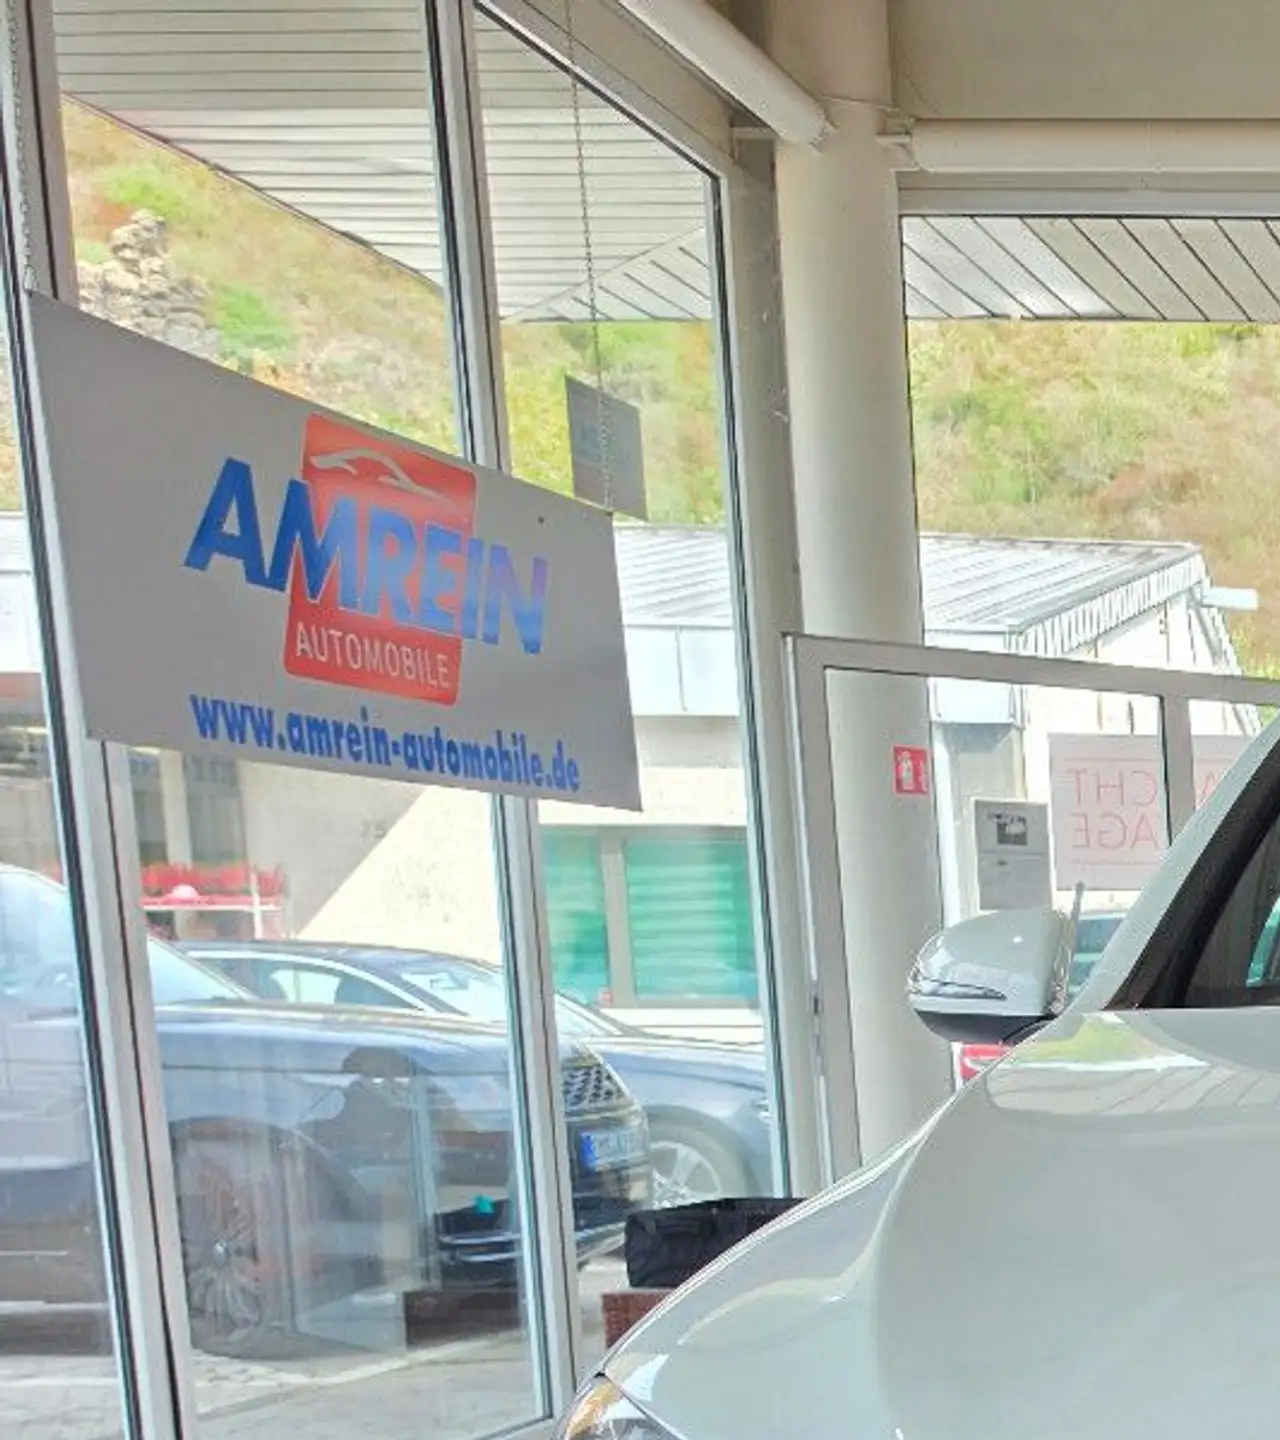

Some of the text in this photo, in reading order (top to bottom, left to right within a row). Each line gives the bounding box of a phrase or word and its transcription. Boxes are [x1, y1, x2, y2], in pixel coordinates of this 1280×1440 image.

[184, 457, 549, 654] AMREIN
[296, 621, 452, 689] AUTOMOBILE
[189, 693, 581, 792] www.amrein-automobile.de
